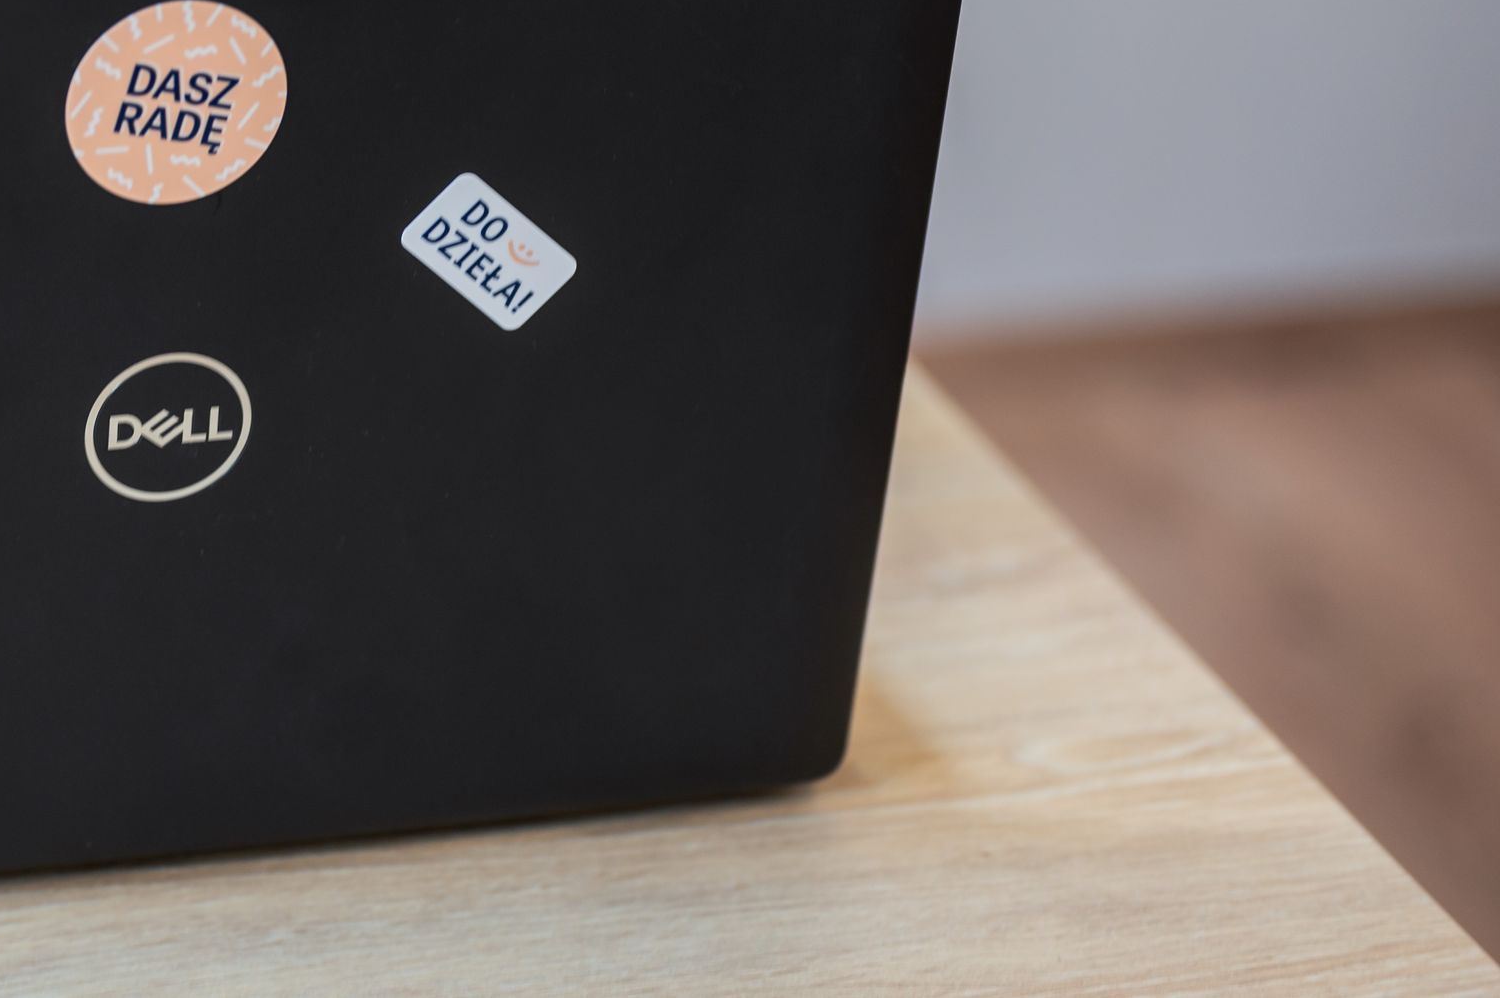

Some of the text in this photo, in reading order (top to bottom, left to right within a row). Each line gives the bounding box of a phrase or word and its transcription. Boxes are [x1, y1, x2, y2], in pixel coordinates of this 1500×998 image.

[126, 62, 240, 110] DASZ
[113, 101, 228, 156] RADĘ
[460, 199, 509, 242] DO
[421, 216, 534, 314] DZIEŁA!
[107, 405, 233, 451] DELL
